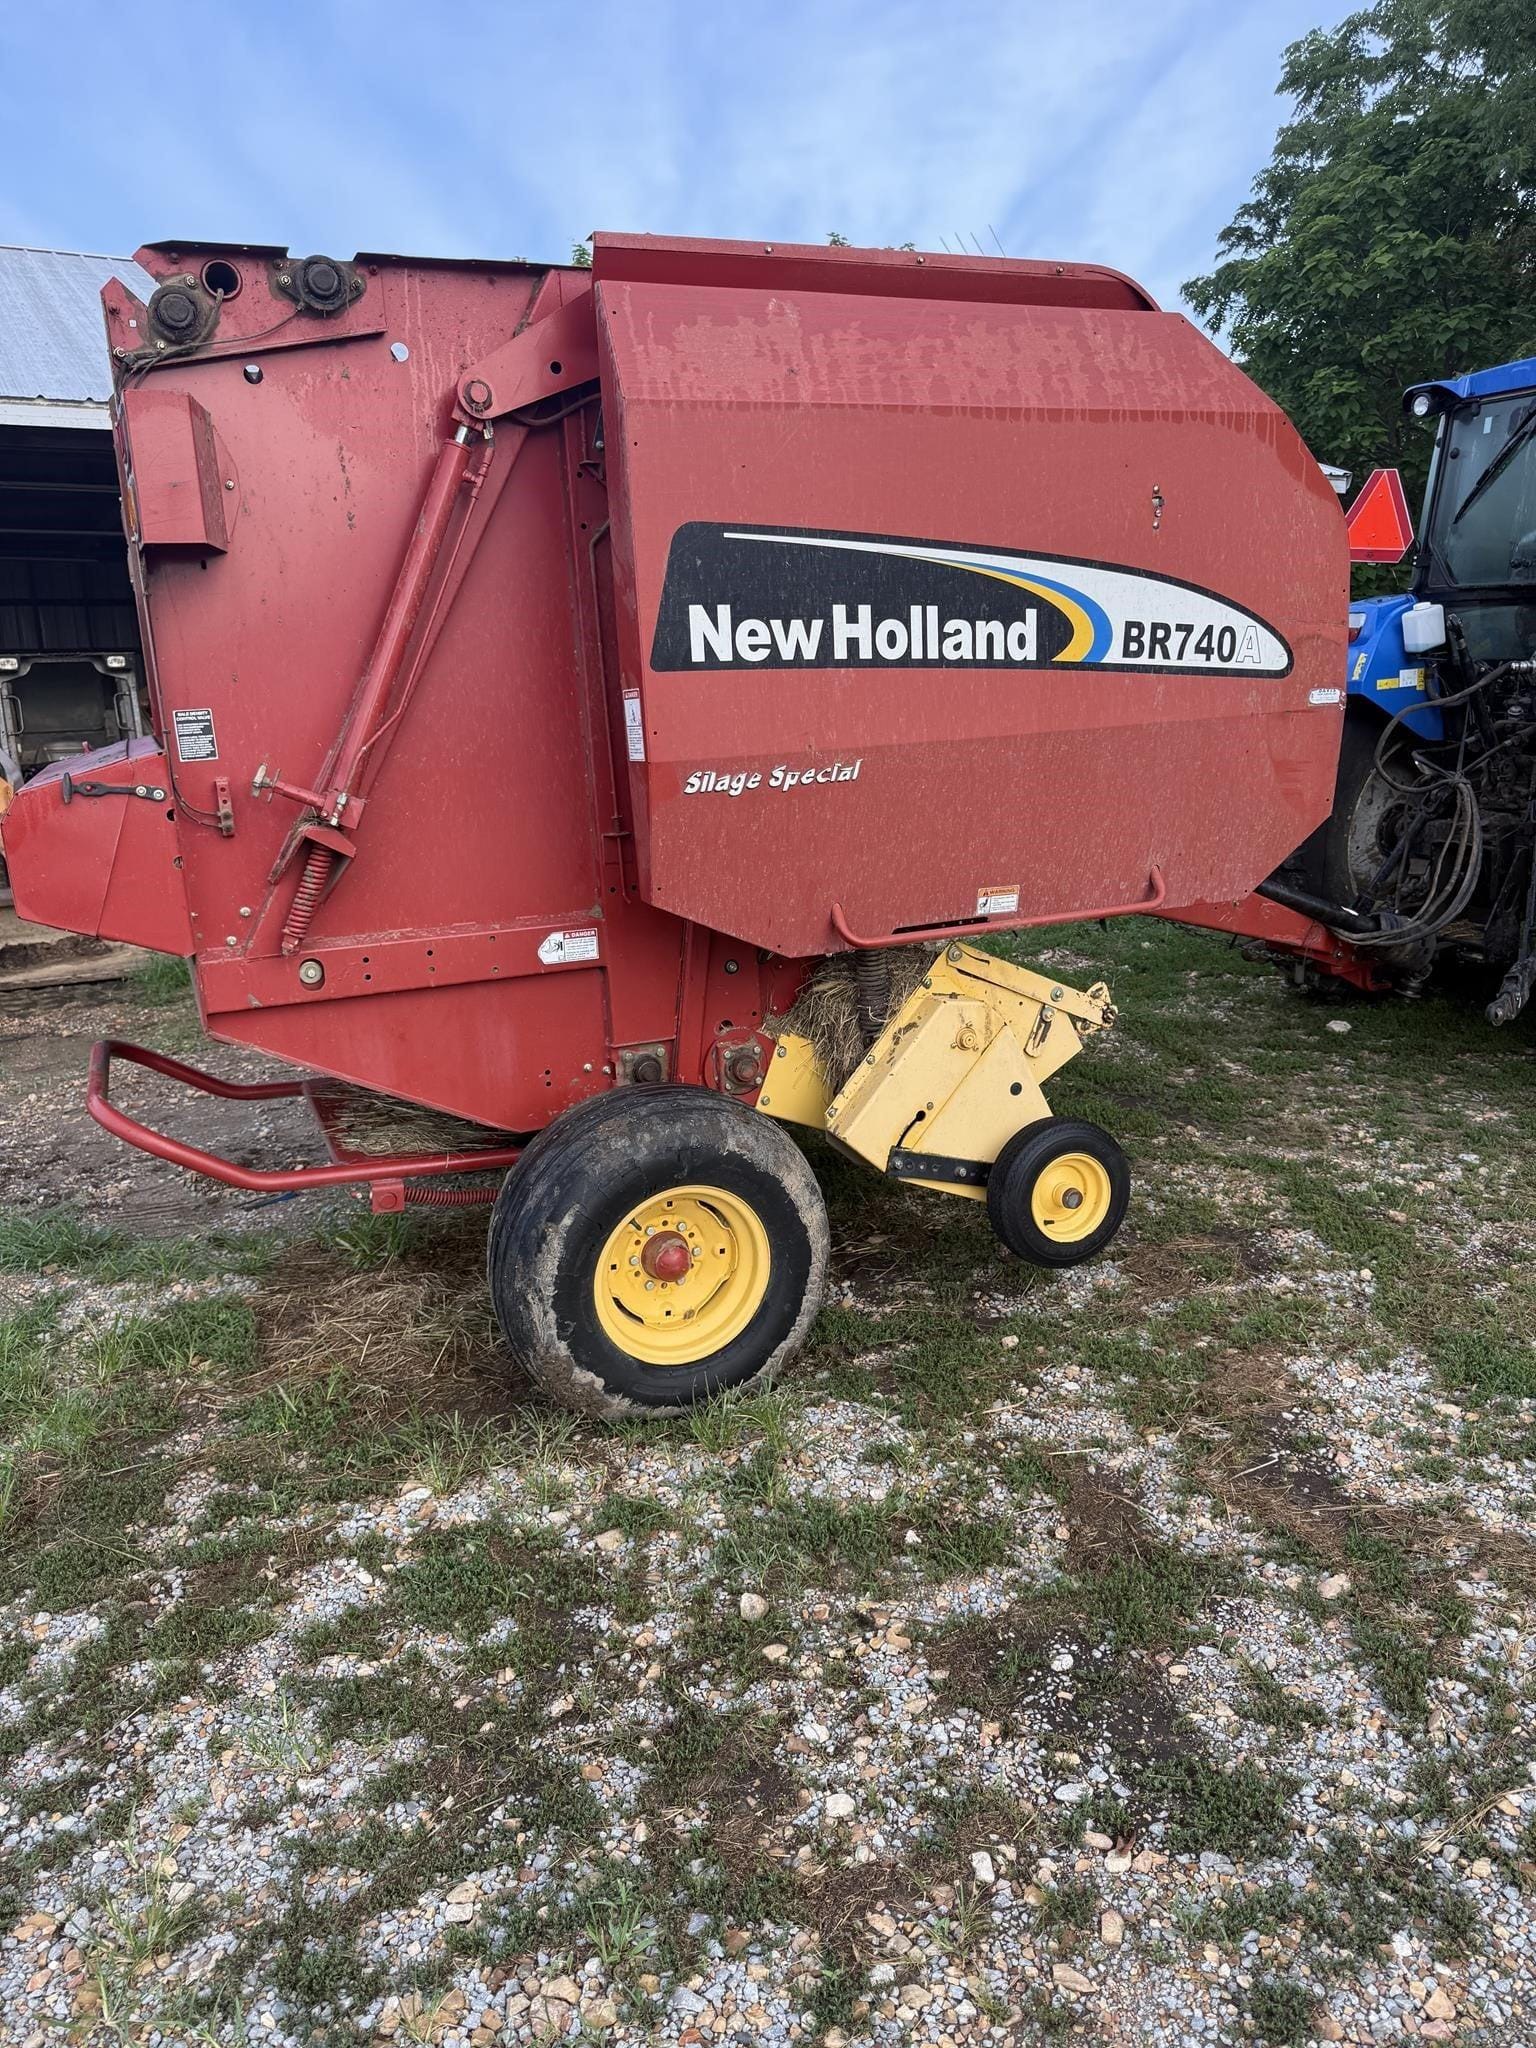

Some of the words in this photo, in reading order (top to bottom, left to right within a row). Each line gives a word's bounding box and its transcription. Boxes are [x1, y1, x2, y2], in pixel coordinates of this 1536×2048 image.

[688, 604, 824, 663] New
[833, 604, 1037, 662] Holland
[1122, 620, 1262, 664] BR740A
[684, 770, 763, 797] Silage
[768, 758, 864, 792] Special
[571, 930, 596, 938] DANGER
